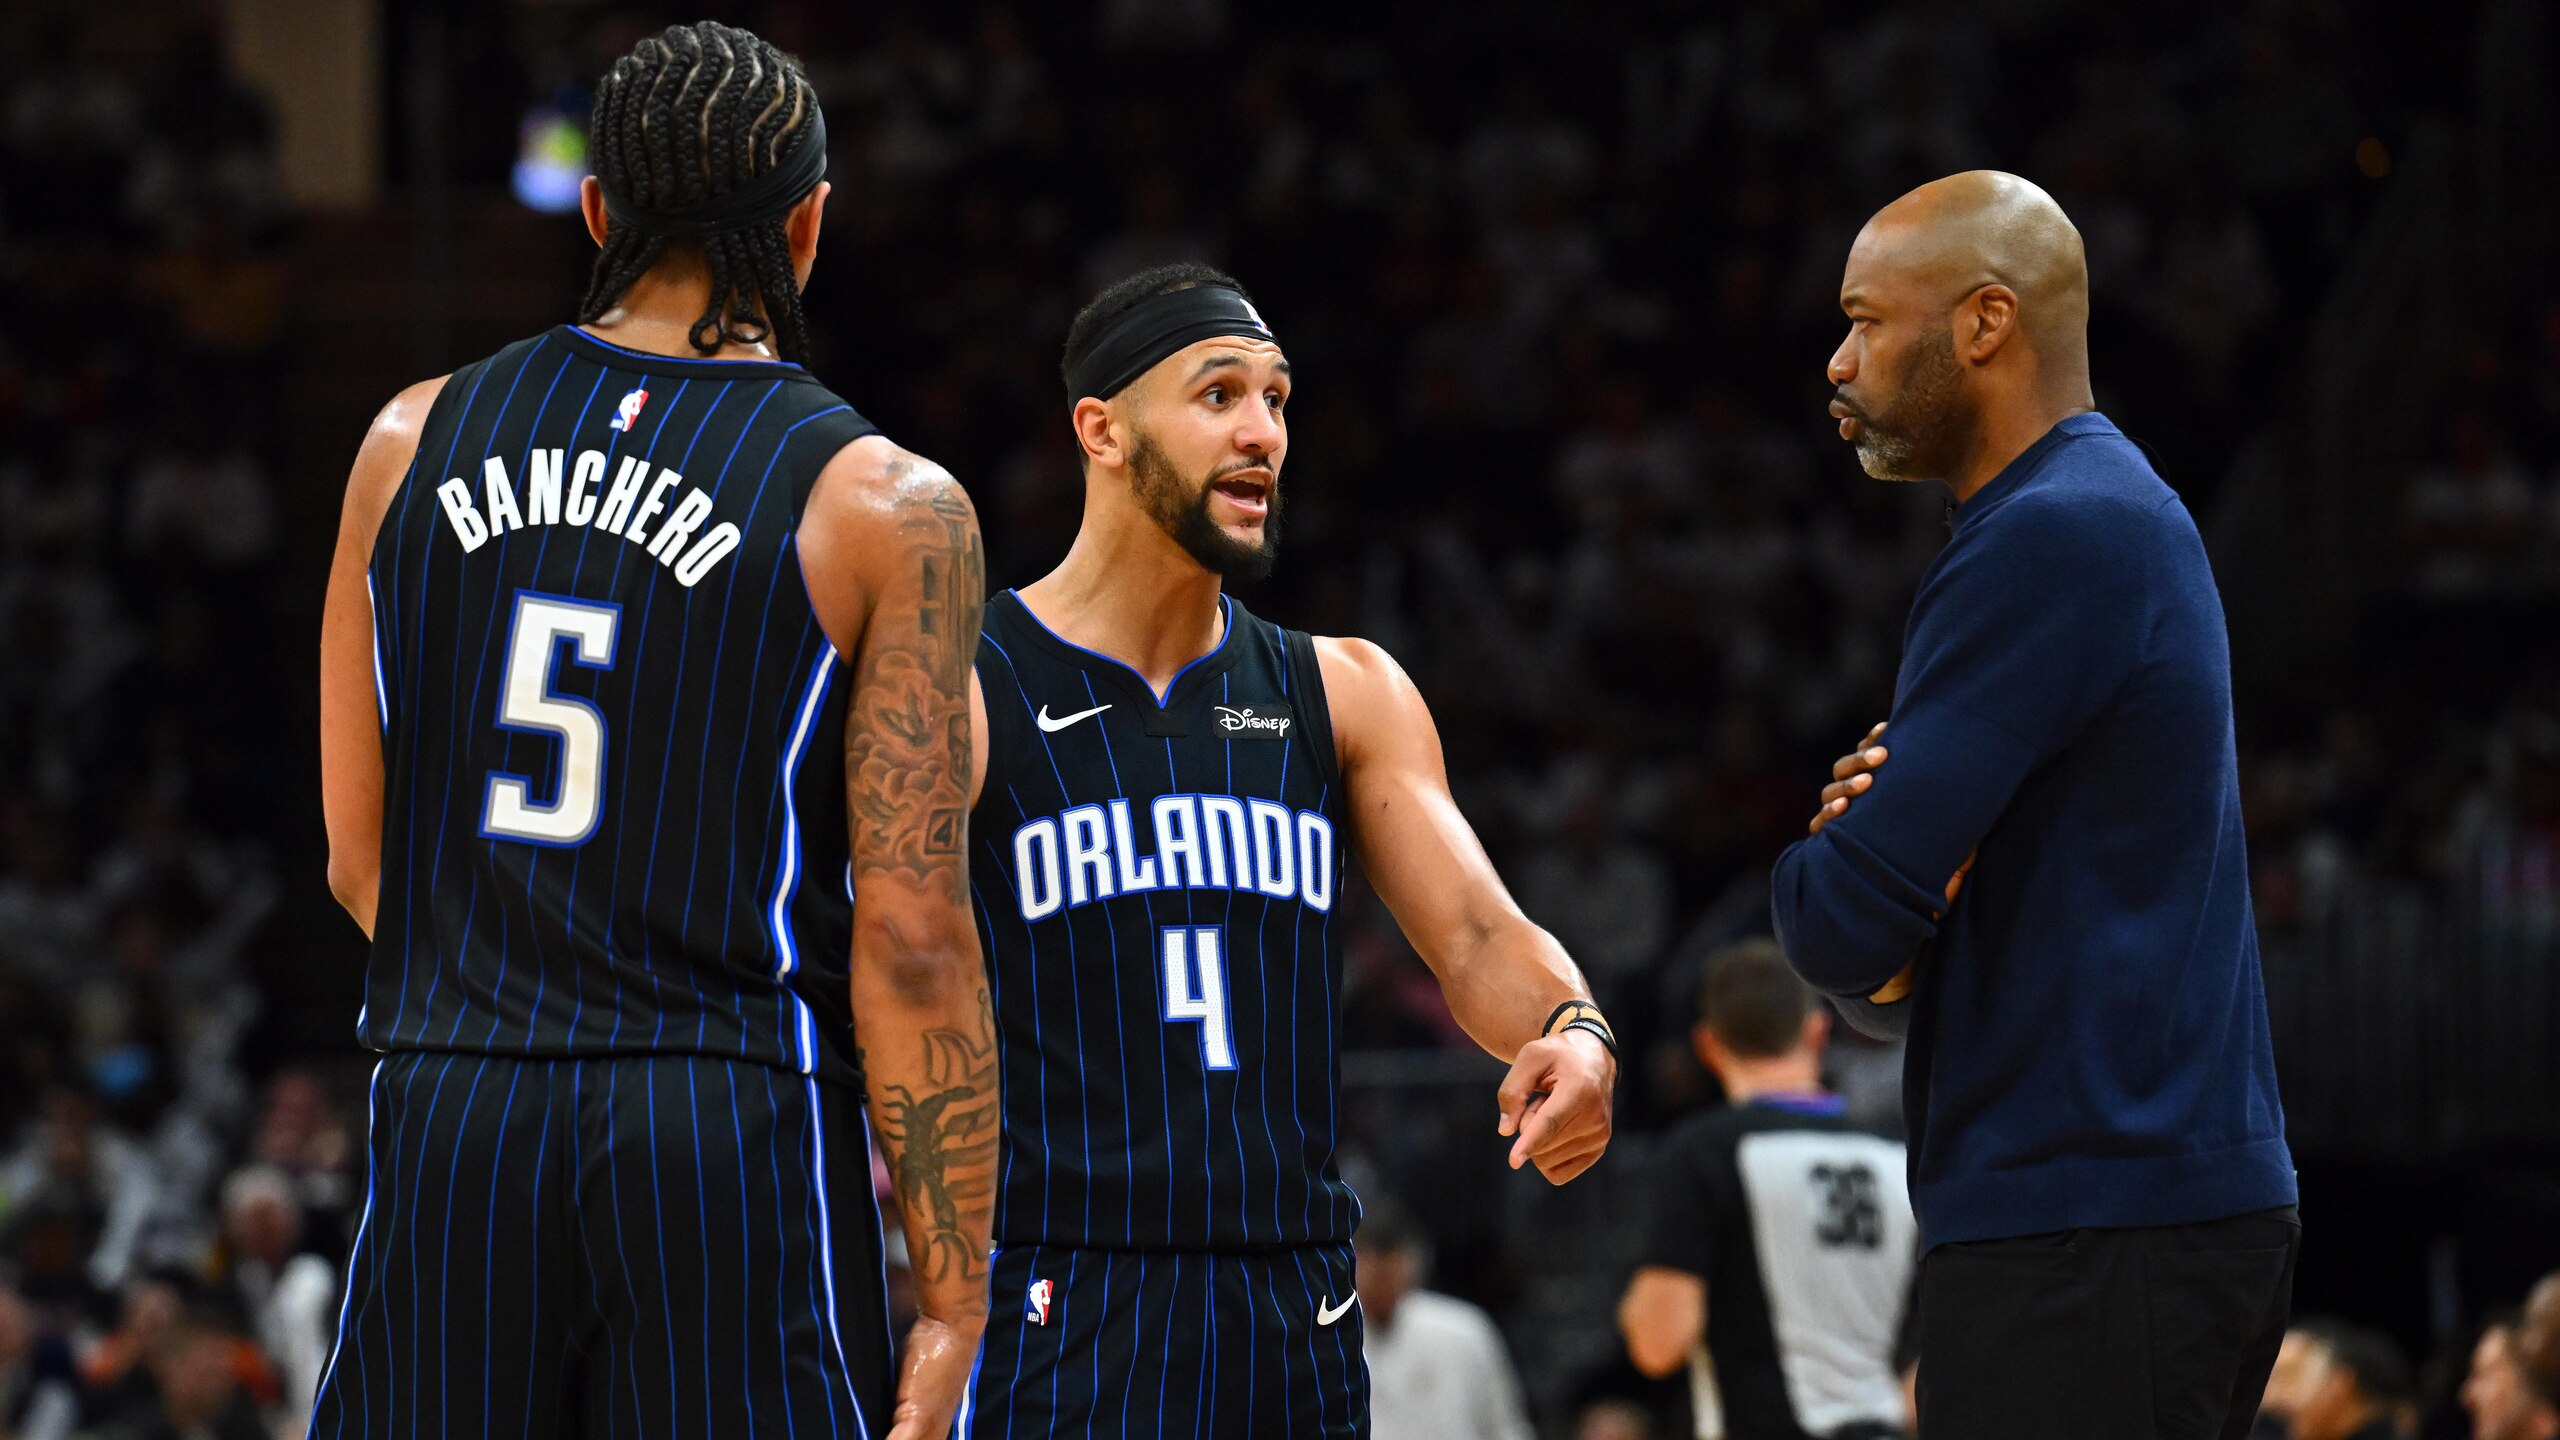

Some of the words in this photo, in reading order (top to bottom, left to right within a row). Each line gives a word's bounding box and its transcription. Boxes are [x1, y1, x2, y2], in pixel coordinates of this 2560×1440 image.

[437, 448, 741, 587] BANCHERO
[477, 588, 623, 849] 5
[1214, 706, 1290, 737] Disney
[1011, 792, 1335, 923] ORLANDO
[1160, 924, 1238, 1070] 4
